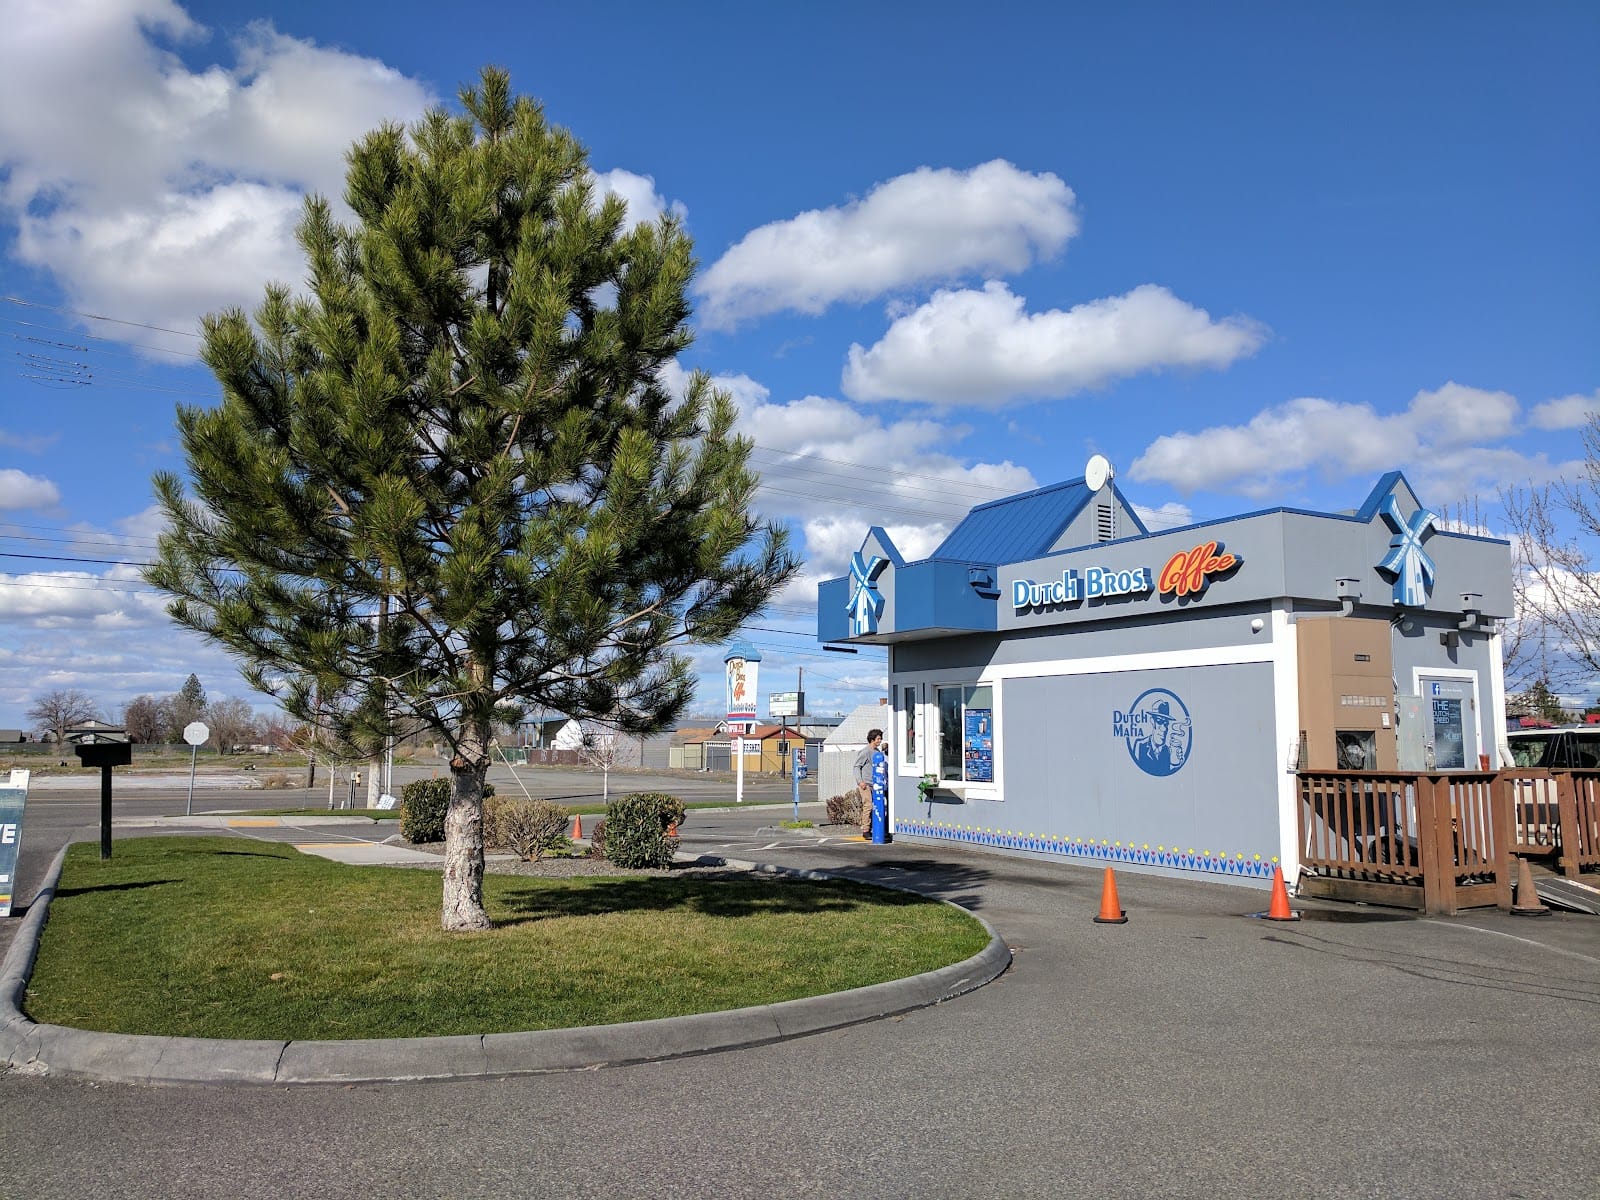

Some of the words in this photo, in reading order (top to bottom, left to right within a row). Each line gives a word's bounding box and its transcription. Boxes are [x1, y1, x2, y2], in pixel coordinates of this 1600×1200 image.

[1012, 569, 1078, 608] DUTCH
[1158, 541, 1236, 596] Coffee
[1433, 700, 1449, 711] THE
[1113, 709, 1148, 723] DUTCH
[1113, 723, 1144, 737] MAFIA
